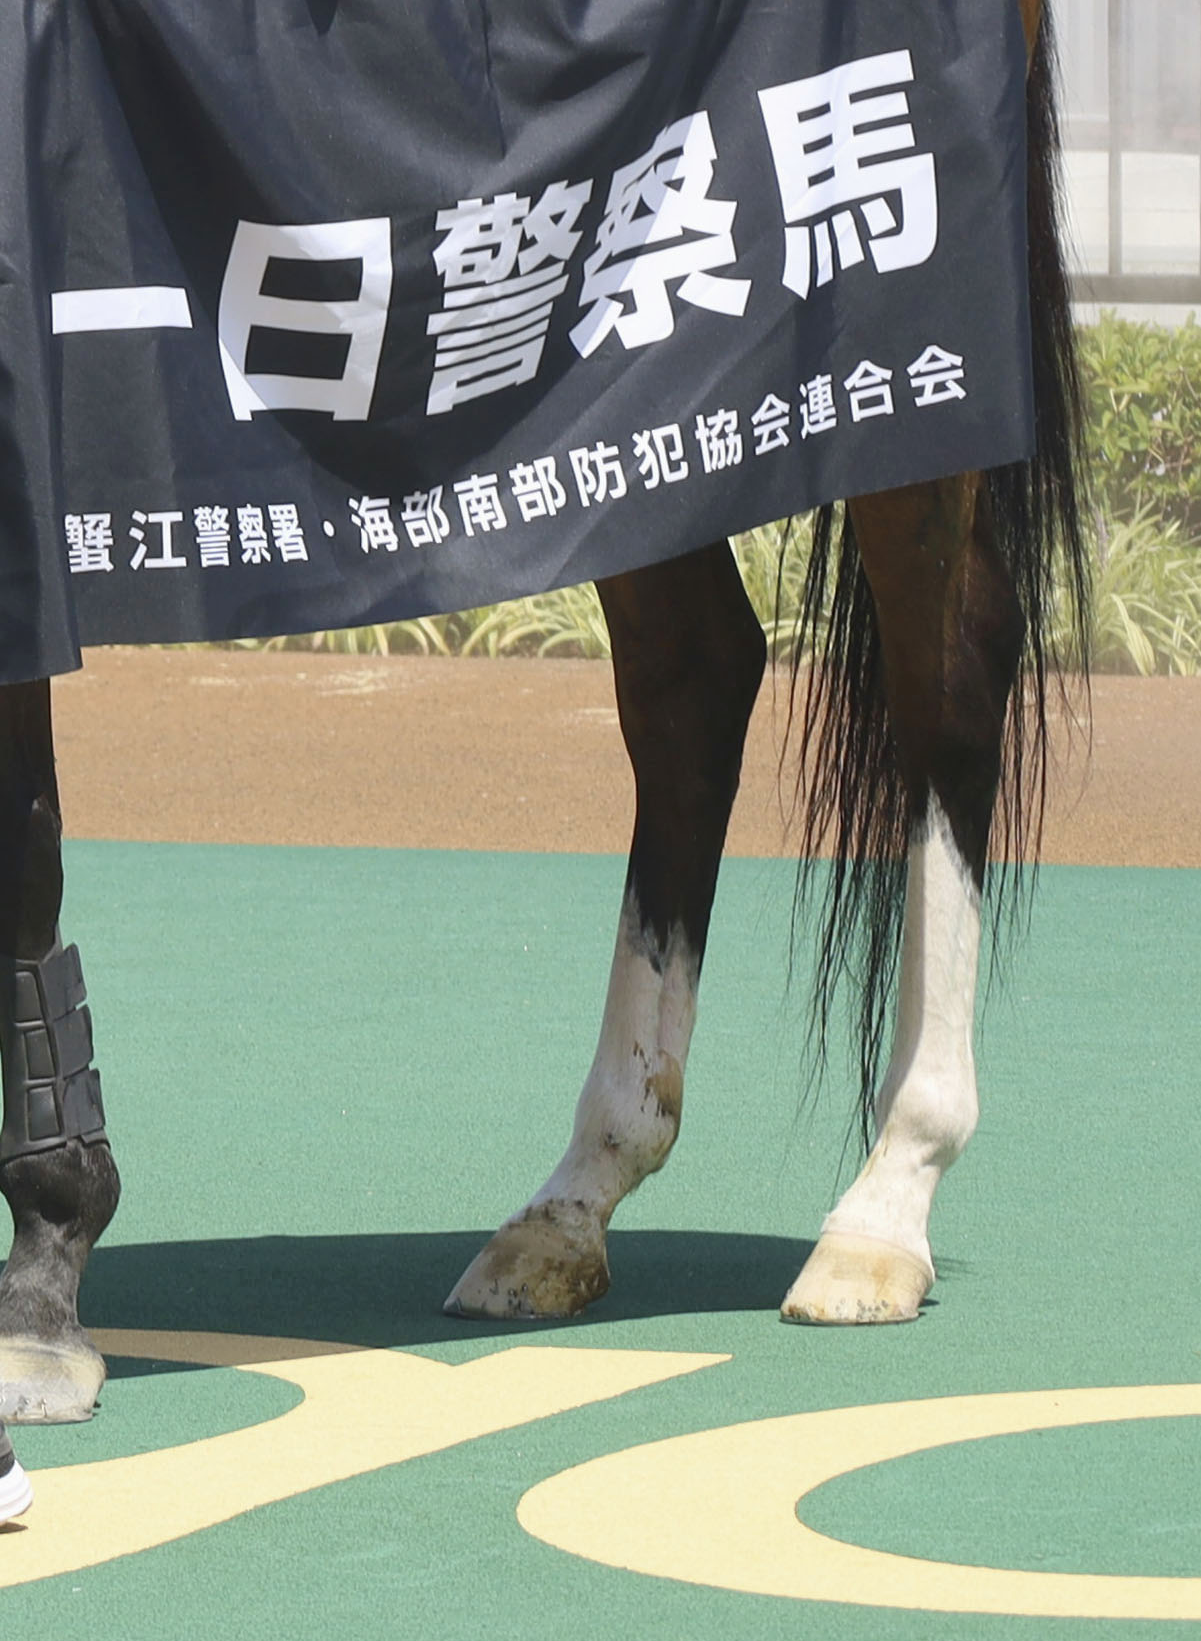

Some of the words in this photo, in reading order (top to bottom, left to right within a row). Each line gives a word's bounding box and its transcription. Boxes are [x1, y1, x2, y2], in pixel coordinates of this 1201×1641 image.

[51, 49, 938, 422] 一日警察馬
